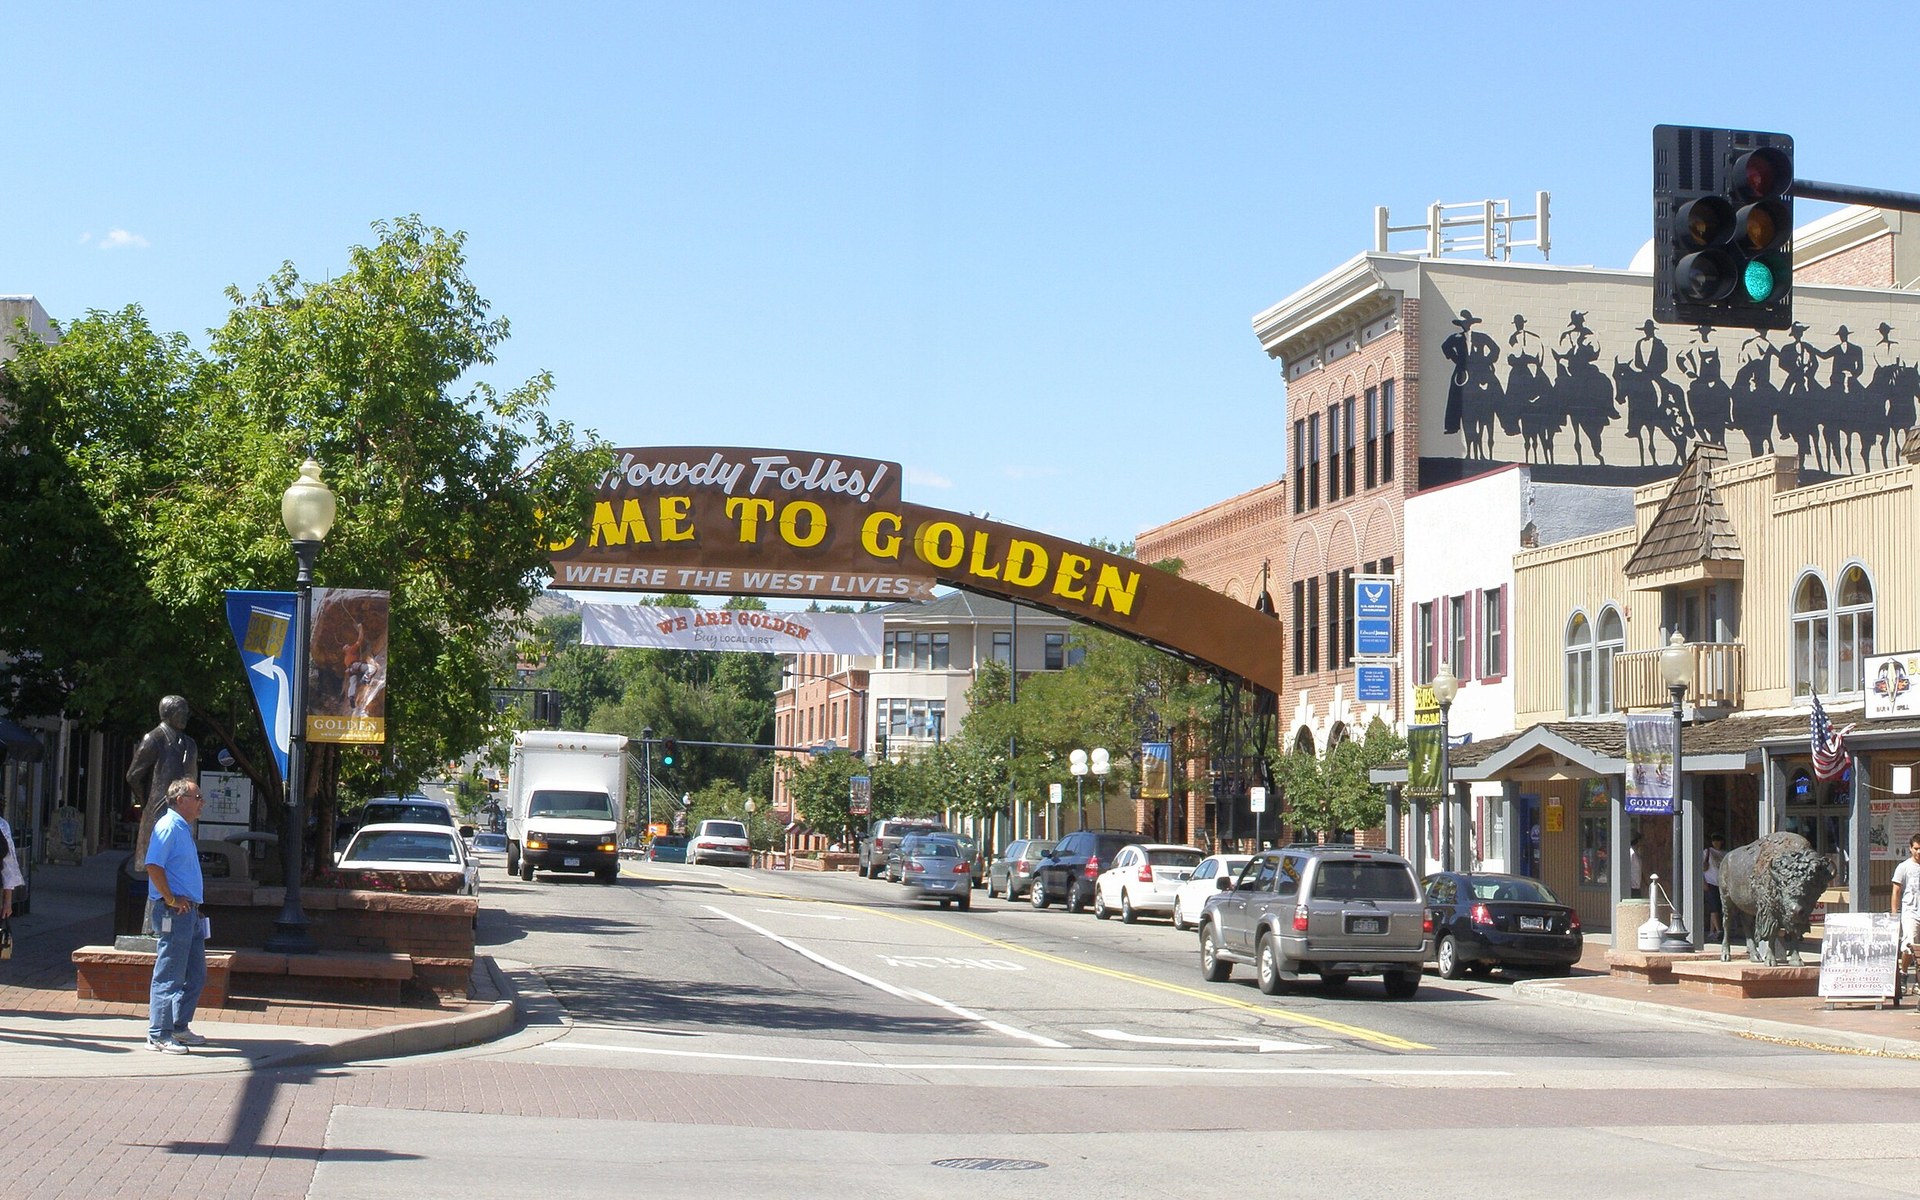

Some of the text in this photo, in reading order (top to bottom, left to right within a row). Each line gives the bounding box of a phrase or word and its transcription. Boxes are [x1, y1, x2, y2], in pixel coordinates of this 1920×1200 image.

[750, 455, 888, 503] Folks!
[725, 497, 828, 548] TO
[861, 511, 1141, 616] GOLDEN
[566, 565, 909, 595] WHERE THE WEST LIVES
[657, 611, 811, 641] WE ARE GOLDEN
[694, 628, 774, 648] Buy LOCAL FIRST
[314, 719, 378, 731] GOLDEN
[1629, 798, 1669, 807] GOLDEN
